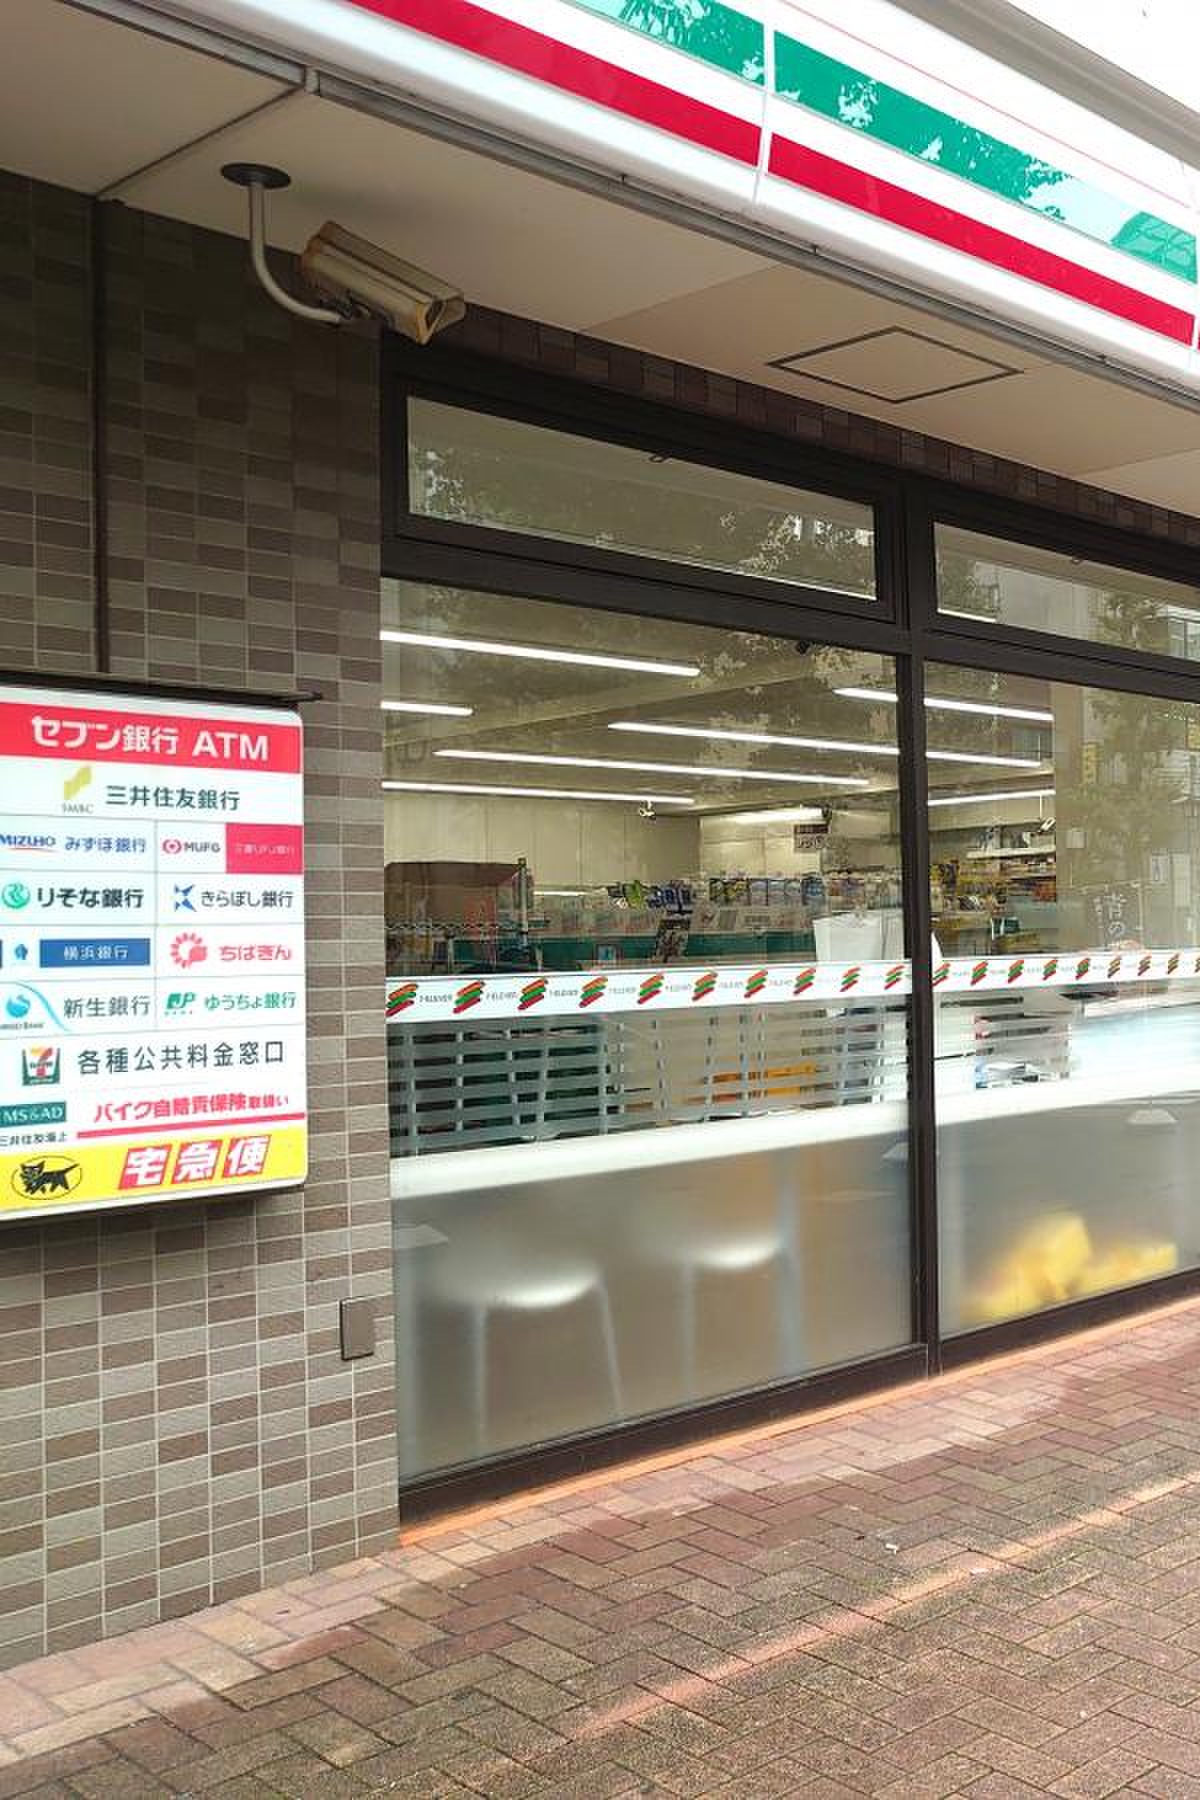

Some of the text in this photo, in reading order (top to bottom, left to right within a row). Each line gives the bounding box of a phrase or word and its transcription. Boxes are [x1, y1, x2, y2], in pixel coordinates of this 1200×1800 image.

[32, 715, 269, 761] セブン銀行 ATM
[106, 785, 240, 811] 三井住友銀行
[65, 836, 146, 853] みずほ銀行
[184, 841, 221, 853] MUFG
[37, 887, 144, 909] りそな銀行
[201, 890, 293, 908] きらぼし銀行
[63, 945, 128, 961] 横浜銀行
[63, 995, 150, 1019] 新生銀行
[204, 991, 296, 1012] ゆうちょ銀行
[77, 1040, 285, 1075] 各種公共料金窓口
[3, 1106, 63, 1121] MS&AD
[120, 1136, 270, 1189] 宅急便
